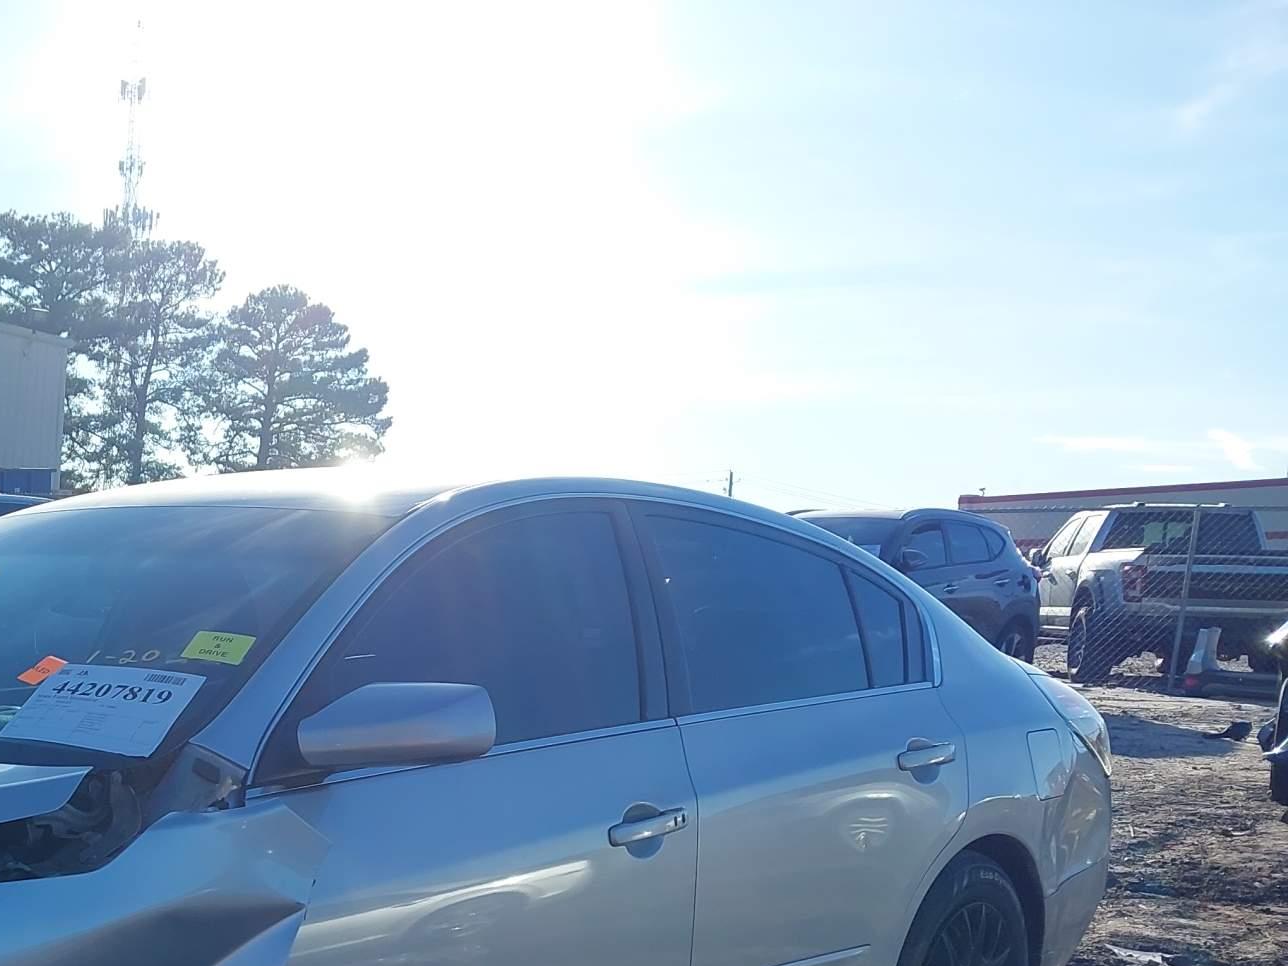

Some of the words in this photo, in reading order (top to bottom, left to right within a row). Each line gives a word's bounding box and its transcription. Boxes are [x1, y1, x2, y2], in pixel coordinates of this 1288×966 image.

[212, 635, 234, 643] RUN
[198, 648, 231, 658] DRIVE
[52, 680, 173, 705] 44207819
